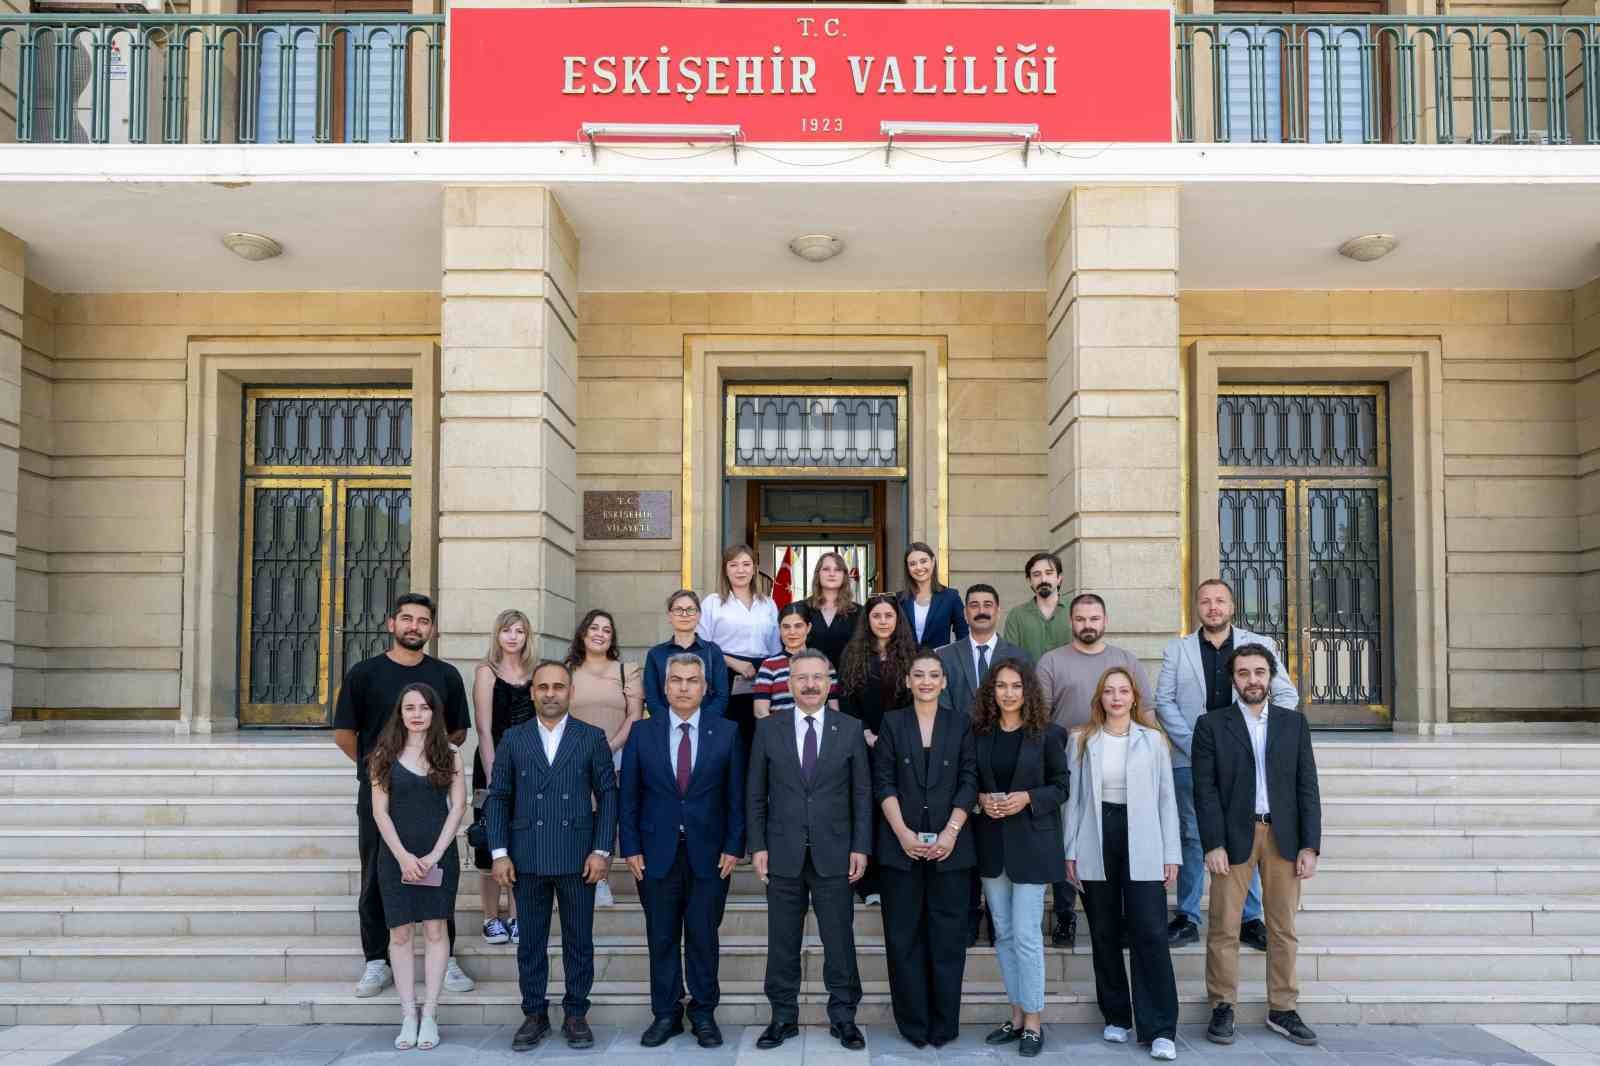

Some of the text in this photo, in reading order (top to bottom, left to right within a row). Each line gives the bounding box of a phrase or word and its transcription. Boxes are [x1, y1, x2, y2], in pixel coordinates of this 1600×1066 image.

[562, 43, 1057, 102] ESKİŞEHİR VALİLİĞİ
[801, 118, 844, 132] 1923
